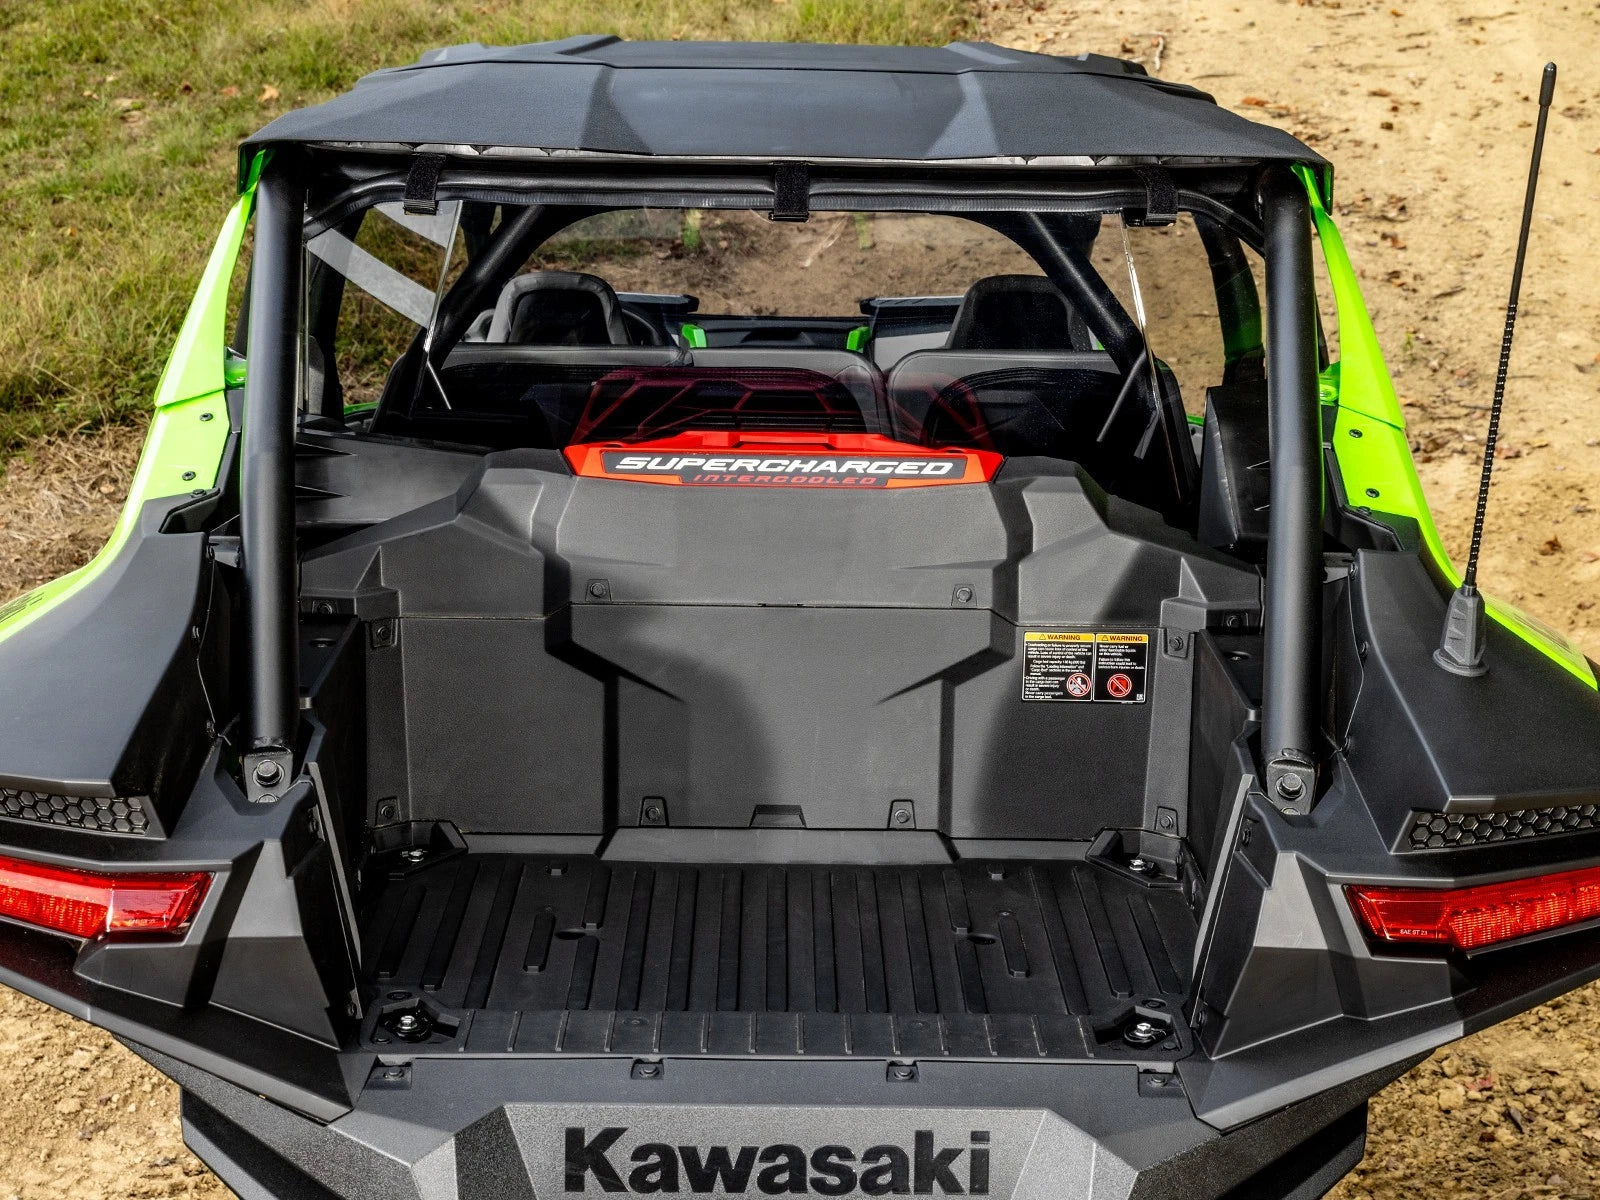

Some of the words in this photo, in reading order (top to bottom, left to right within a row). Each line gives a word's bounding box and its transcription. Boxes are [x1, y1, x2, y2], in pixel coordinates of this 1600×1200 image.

[615, 456, 954, 475] SUPERCHARGED
[693, 474, 879, 487] INTERCOOLED
[564, 1127, 991, 1197] Kawasaki
